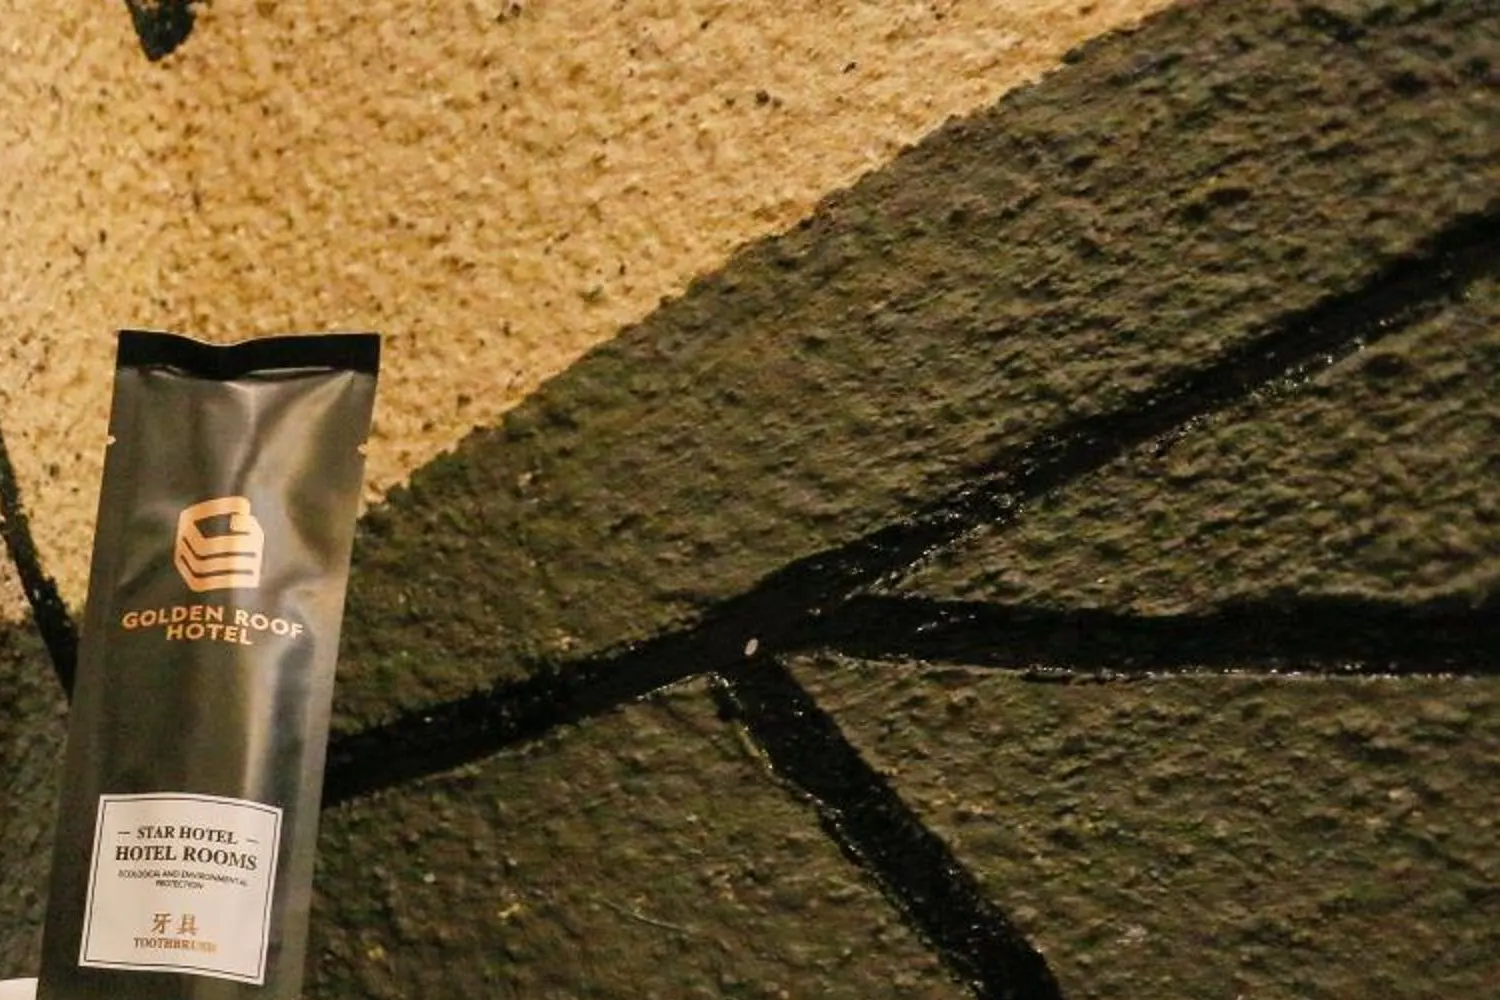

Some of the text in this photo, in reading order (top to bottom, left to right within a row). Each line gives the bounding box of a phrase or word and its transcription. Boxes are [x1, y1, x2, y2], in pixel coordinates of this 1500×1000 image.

[122, 605, 304, 640] GOLDEN ROOF
[166, 623, 254, 645] HOTEL
[136, 826, 238, 844] STAR HOTEL
[115, 845, 258, 871] HOTEL ROOMS
